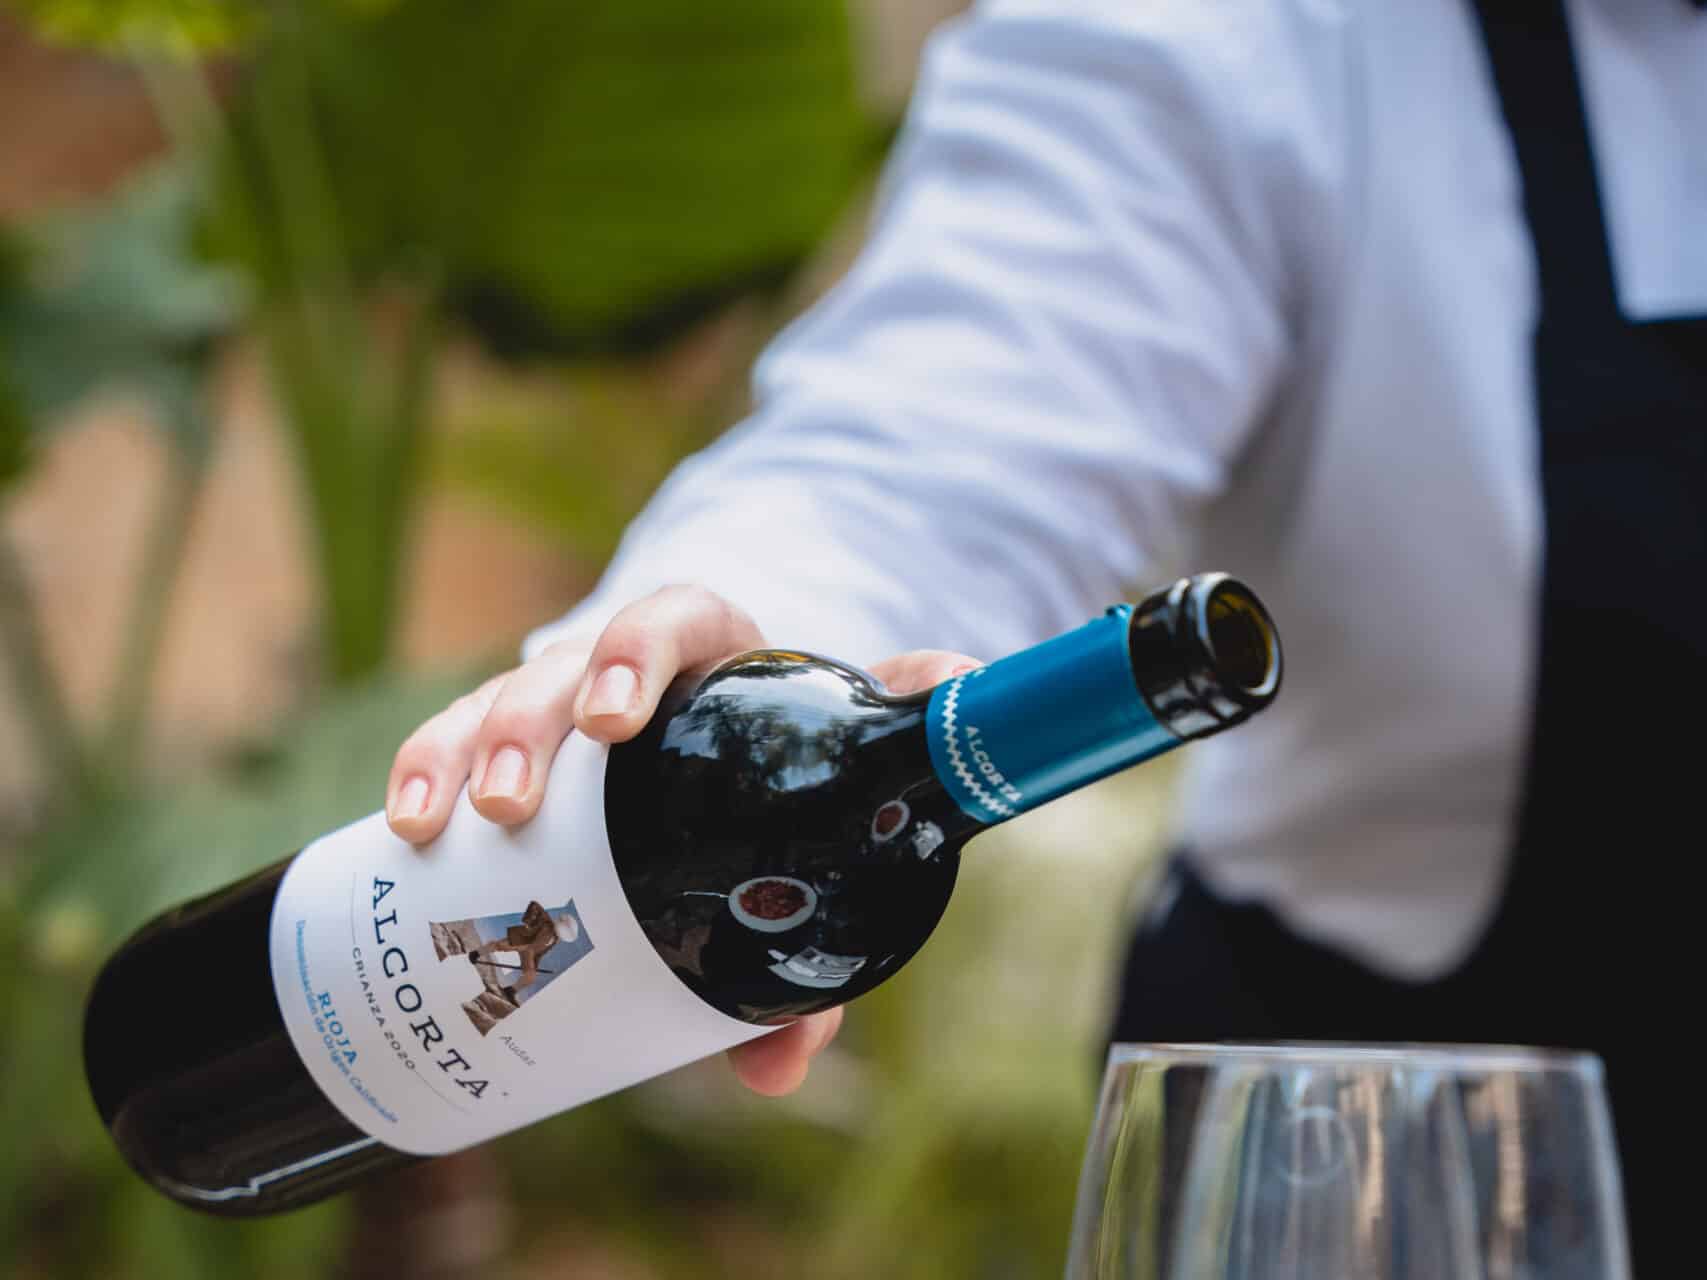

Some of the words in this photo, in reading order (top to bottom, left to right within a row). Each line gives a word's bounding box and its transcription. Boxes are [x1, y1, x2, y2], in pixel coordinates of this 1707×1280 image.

[966, 725, 1023, 802] ALCORTA
[317, 991, 357, 1066] RIOJA
[352, 947, 386, 1028] CRIANZA
[383, 1031, 416, 1070] 2020
[373, 876, 489, 1098] ALCORTA
